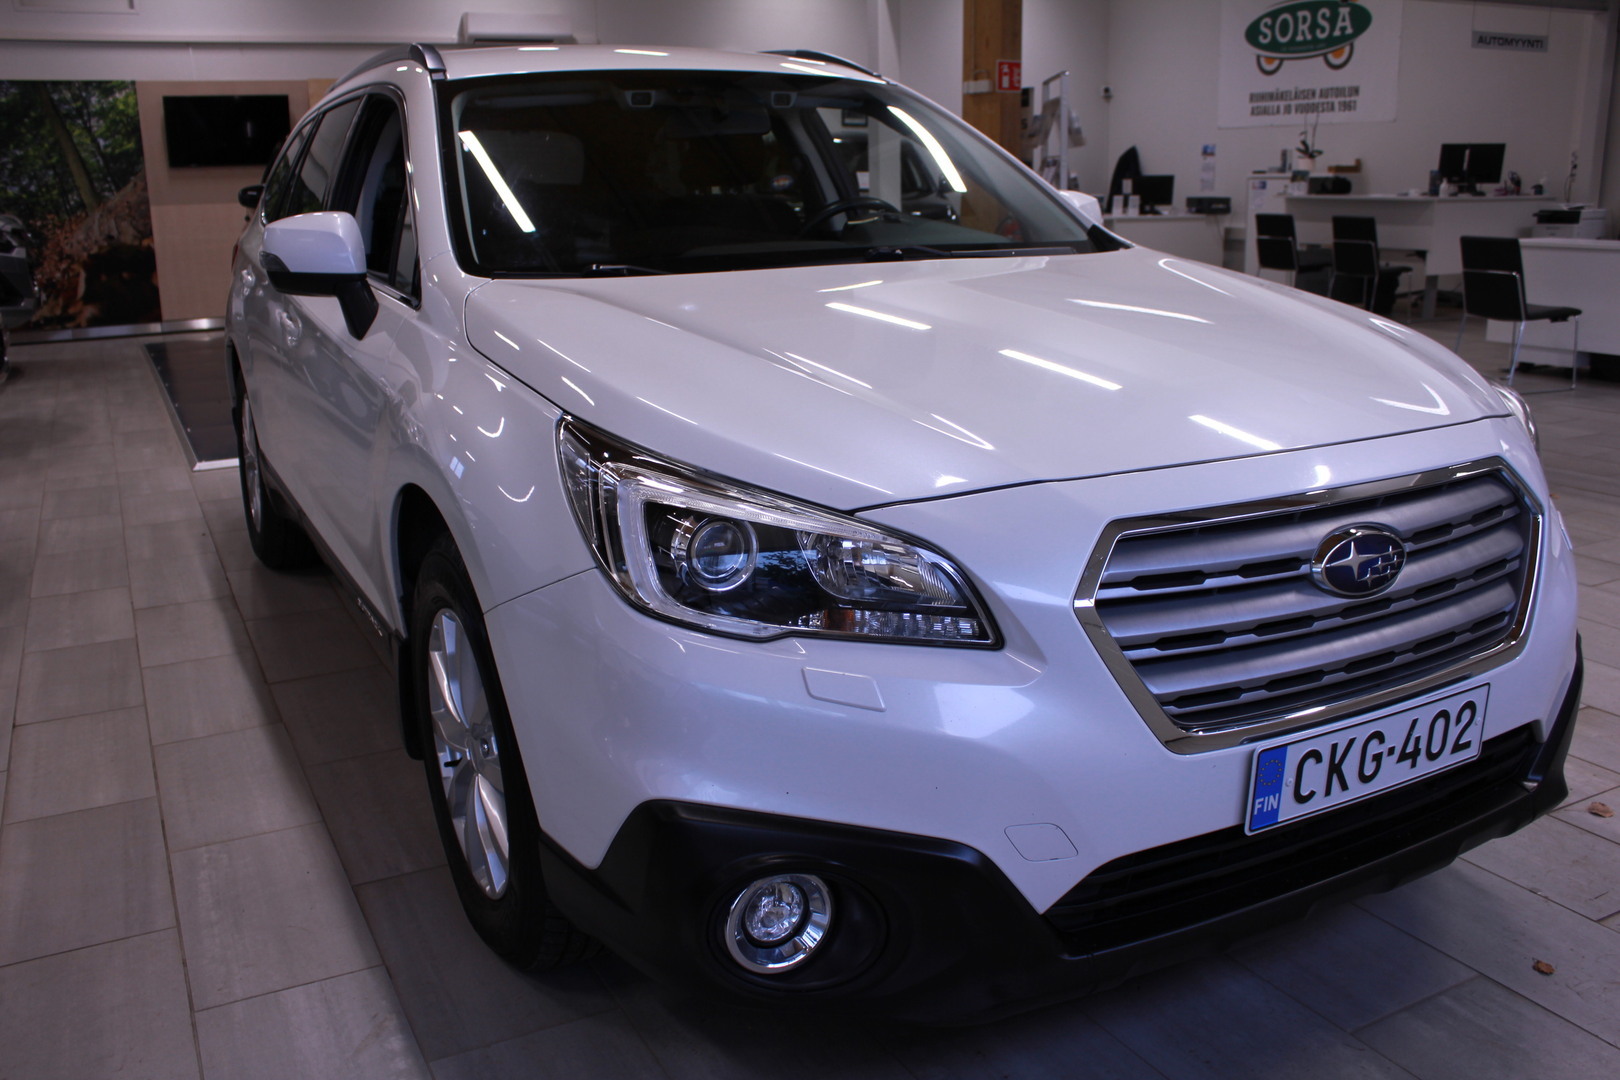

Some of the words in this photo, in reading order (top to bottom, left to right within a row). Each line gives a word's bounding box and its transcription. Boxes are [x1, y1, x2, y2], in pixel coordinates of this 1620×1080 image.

[1258, 6, 1354, 45] SORSA
[1477, 35, 1544, 49] AUTOMYYNTI
[1318, 85, 1361, 99] AUTOILUN
[1250, 104, 1281, 116] ASIALLA
[1294, 101, 1336, 114] VUODESTA
[1293, 700, 1477, 804] CKG-402
[1253, 792, 1280, 816] FIN
